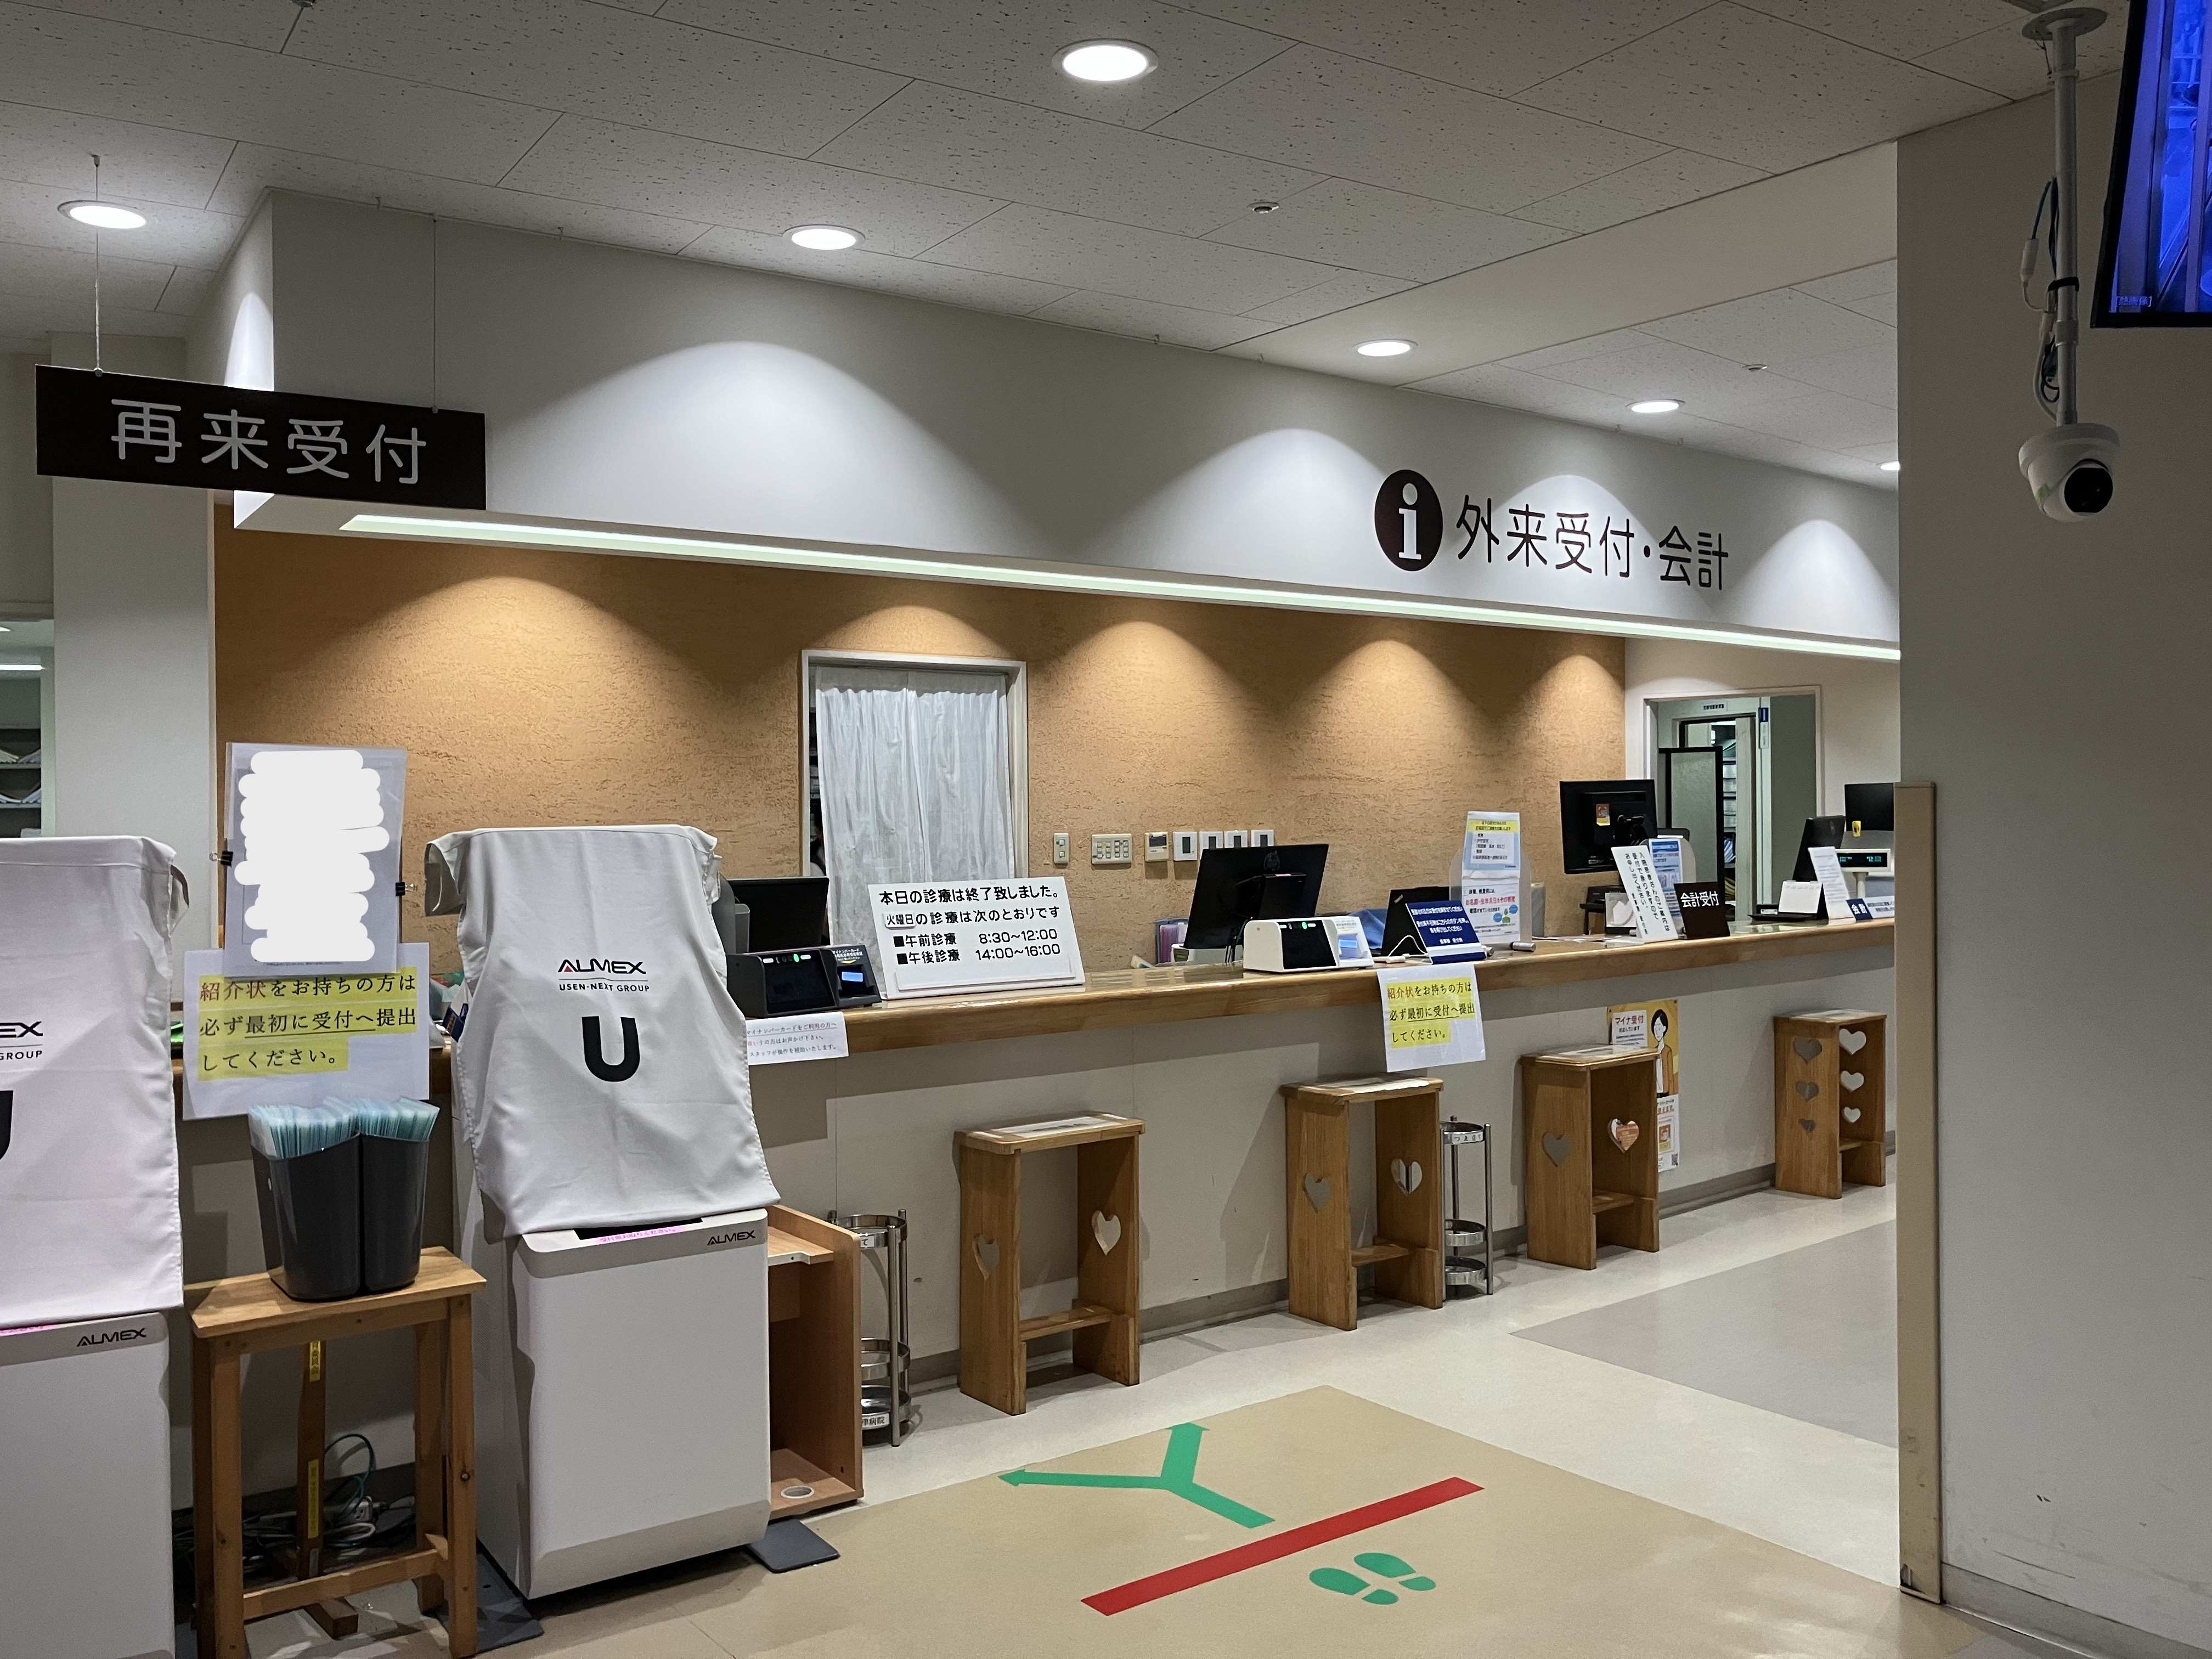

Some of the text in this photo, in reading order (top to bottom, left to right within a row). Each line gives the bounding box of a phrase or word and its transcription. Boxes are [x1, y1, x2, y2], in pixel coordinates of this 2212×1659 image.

[111, 399, 426, 484] 再来受付
[1457, 495, 1729, 590] 外来受付・会計
[879, 885, 1058, 905] 本日の診療は終了致しました。
[1680, 891, 1719, 907] 会計受付
[887, 906, 1059, 926] 火曜日の診療は次のとおりです
[1851, 904, 1867, 915] 会計
[558, 958, 646, 974] ALMEX
[200, 974, 415, 1001] 紹介状をお持ちの方は
[559, 983, 613, 991] USEN-NEXT
[1387, 982, 1471, 1000] 紹介状をお持ちの方は
[1390, 1002, 1475, 1021] 必ず最初に受付へ提出
[200, 1007, 415, 1037] 必ず最初に受付へ提出
[1392, 1029, 1446, 1043] してください。
[582, 1015, 641, 1082] U
[204, 1048, 335, 1071] してください。
[707, 1230, 755, 1245] ALMEX
[77, 1328, 146, 1347] ALMEX
